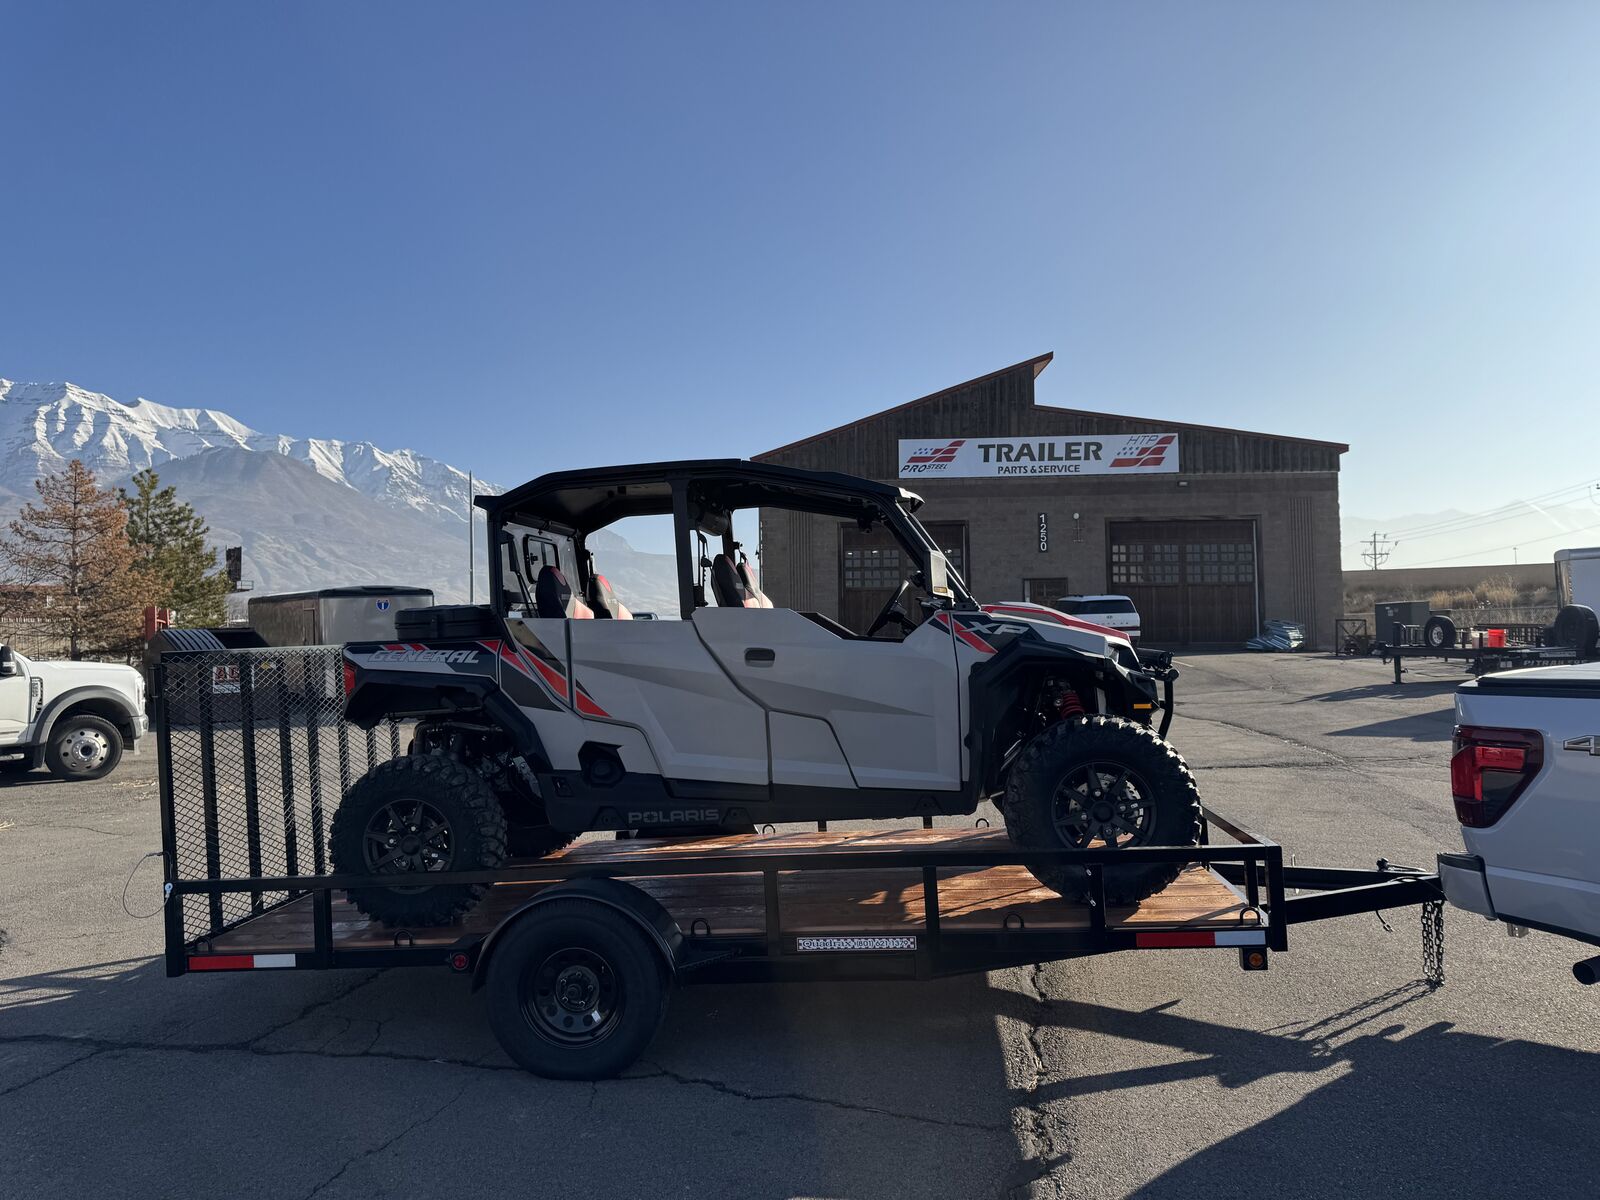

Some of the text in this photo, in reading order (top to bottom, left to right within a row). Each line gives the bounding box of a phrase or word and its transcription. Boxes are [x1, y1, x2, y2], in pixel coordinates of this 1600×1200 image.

[1127, 434, 1158, 445] HTP
[978, 441, 1103, 463] TRAILER
[997, 464, 1080, 475] PARTS & SERVICE
[1039, 513, 1047, 552] 1250
[960, 621, 1030, 635] XP
[368, 650, 479, 664] GENERAL
[628, 809, 719, 824] POLARIS
